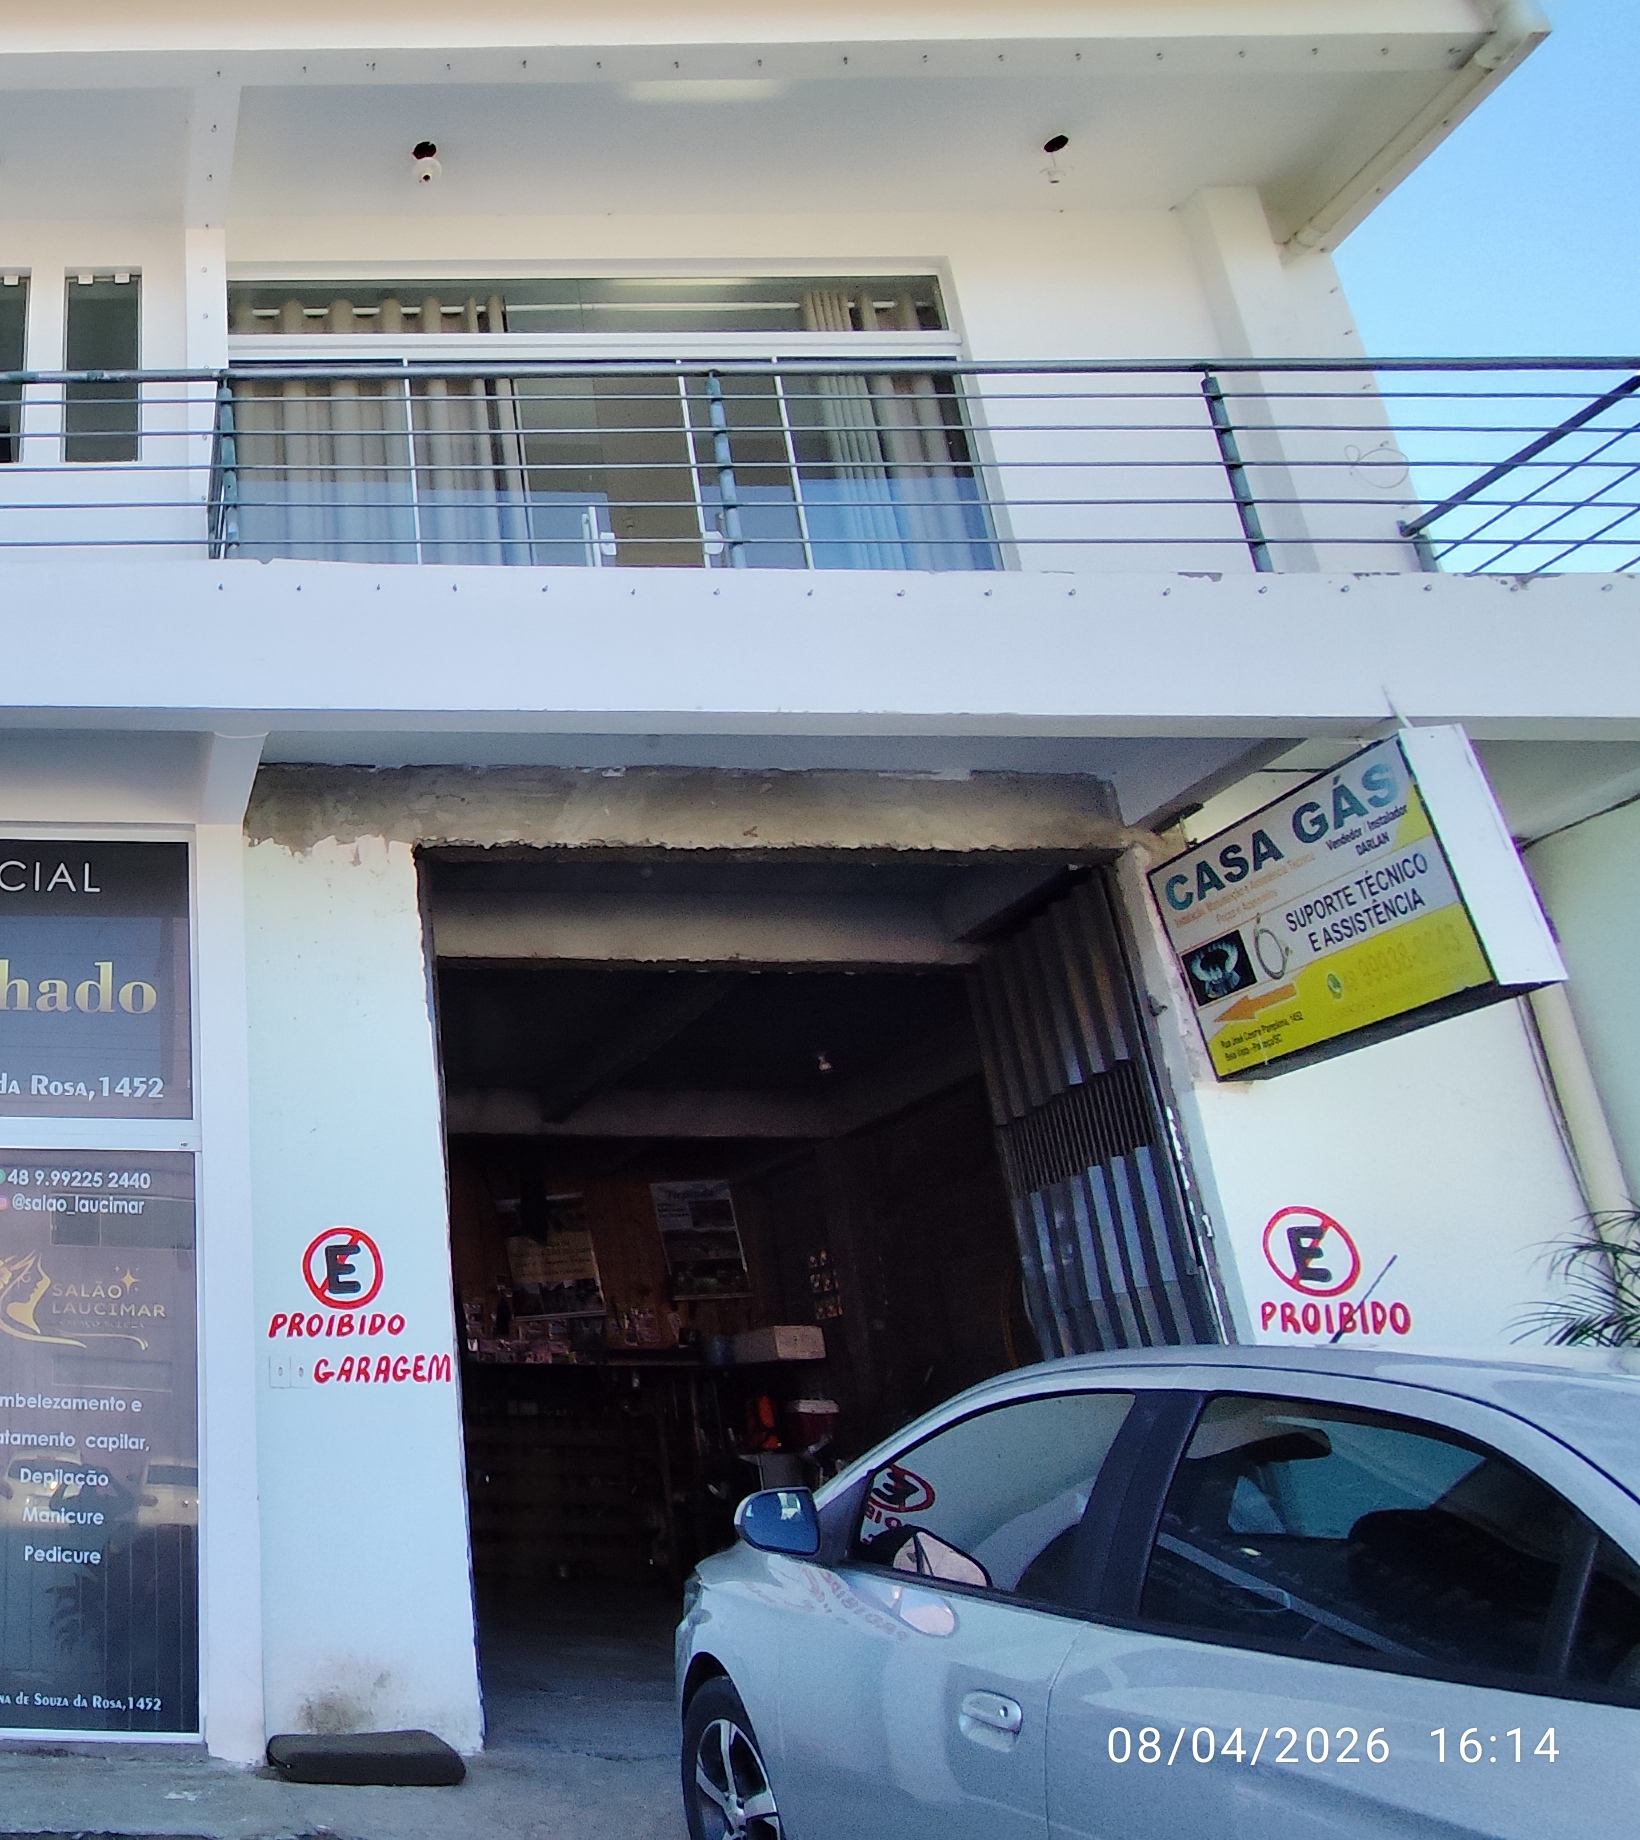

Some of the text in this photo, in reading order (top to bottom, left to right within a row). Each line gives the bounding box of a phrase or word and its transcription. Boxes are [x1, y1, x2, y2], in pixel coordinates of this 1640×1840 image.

[1165, 763, 1401, 911] CASA GÁS
[1326, 828, 1363, 850] Vendedor
[1367, 805, 1407, 831] Instalador
[1355, 832, 1390, 856] DARLAN
[1286, 853, 1428, 932] SUPORTE TÉCNICO
[1308, 887, 1425, 953] E ASSISTÊNCIA
[7, 1169, 151, 1189] 48 9.99225 2440
[12, 1193, 145, 1215] @salao_laucimar
[1287, 1226, 1332, 1282] E
[325, 1244, 361, 1294] E
[52, 1281, 123, 1299] SALÃO
[52, 1302, 166, 1318] LAUCIMAR
[1261, 1301, 1411, 1335] PROIBIDO
[268, 1313, 407, 1339] PROIBIDO
[313, 1353, 452, 1384] GARAGEM
[131, 1399, 143, 1413] e
[85, 1433, 150, 1452] capilar,
[20, 1467, 109, 1488] Depilação
[22, 1506, 105, 1525] Manicure
[24, 1545, 102, 1564] Pedicure
